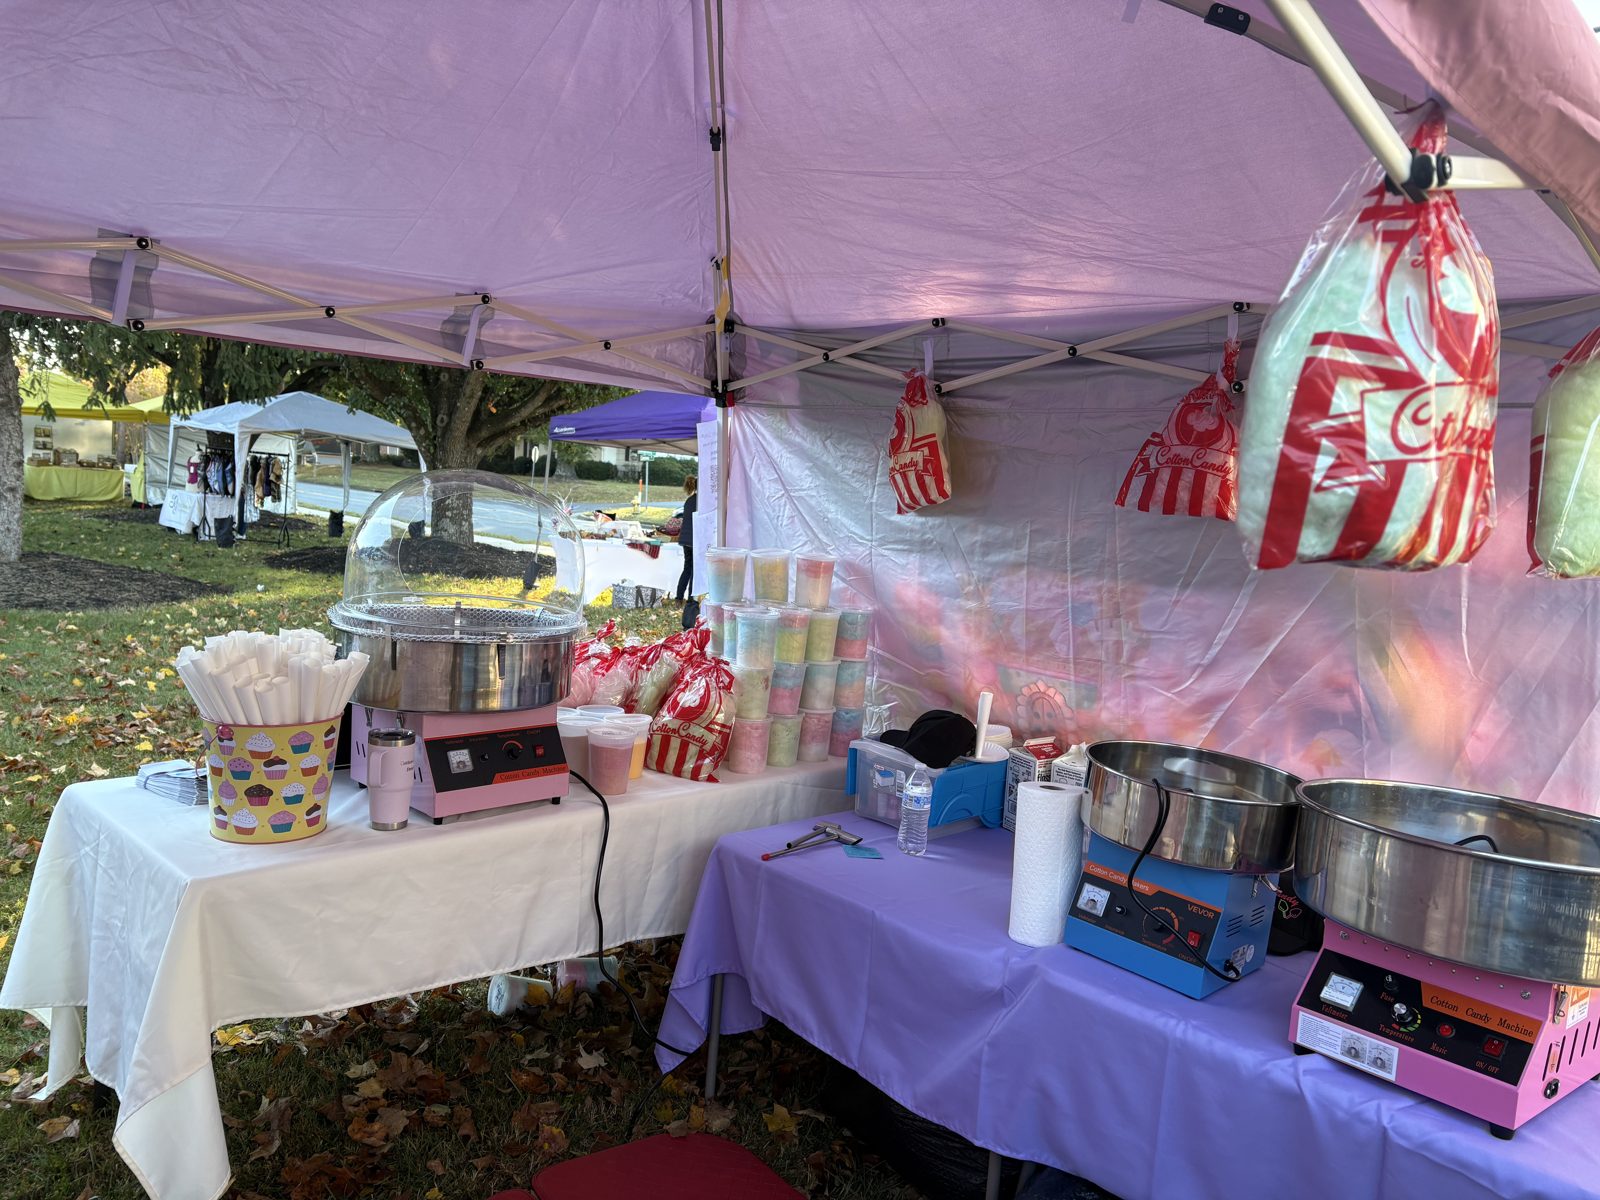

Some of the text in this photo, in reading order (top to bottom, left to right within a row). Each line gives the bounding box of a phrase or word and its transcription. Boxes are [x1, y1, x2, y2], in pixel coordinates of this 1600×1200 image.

[1155, 445, 1233, 479] Cotton Candy
[677, 721, 709, 749] Candy
[1089, 864, 1150, 891] Cotton Candy akers
[1187, 903, 1215, 919] VEVOR
[1380, 991, 1396, 1003] Fuse
[1430, 995, 1534, 1038] Cotton Candy Machine
[1430, 1041, 1448, 1055] Music
